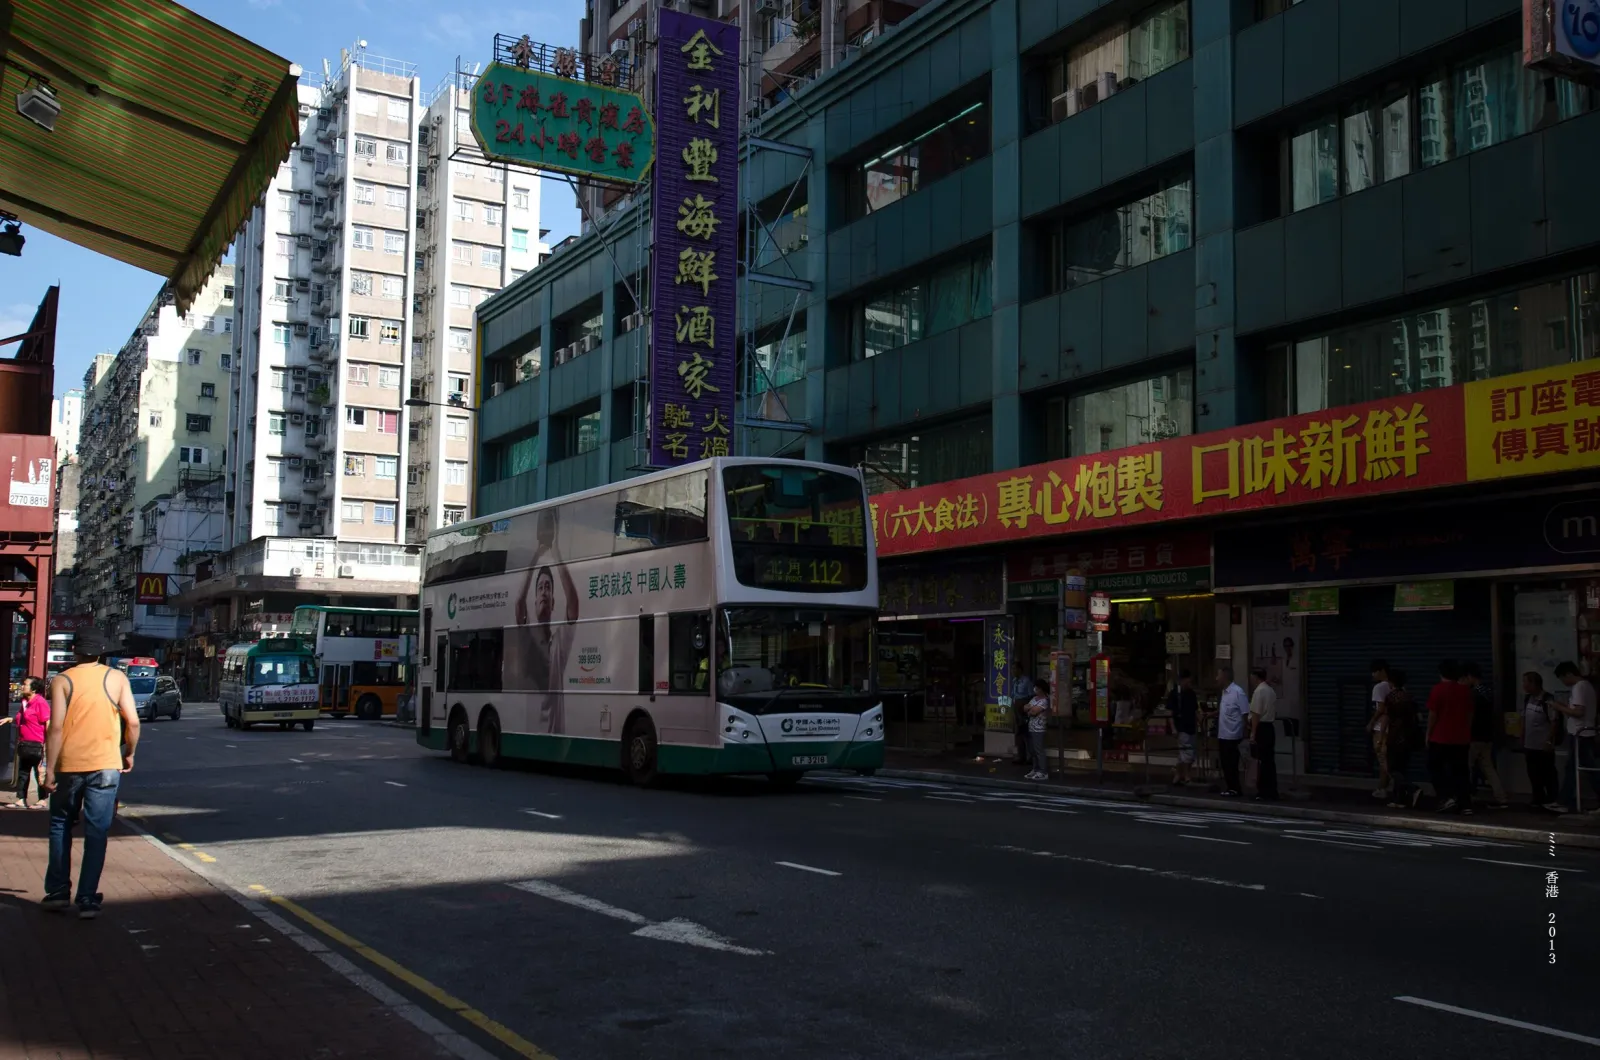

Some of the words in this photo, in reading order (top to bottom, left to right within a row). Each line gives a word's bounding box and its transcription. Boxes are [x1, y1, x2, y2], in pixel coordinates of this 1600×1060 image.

[674, 28, 724, 400] 金利豐海鮮酒家
[661, 403, 695, 459] 馳名
[996, 450, 1165, 530] 專心炮製
[1191, 402, 1431, 506] 口味新鮮
[10, 494, 28, 505] 2770
[30, 495, 48, 506] 8819
[588, 571, 633, 600] 要投就投
[636, 562, 687, 594] 中國人壽
[808, 558, 843, 585] 112
[1097, 575, 1142, 590] HOUSEHOLD
[1145, 571, 1188, 585] PRODUCTS
[992, 622, 1008, 695] 永勝會
